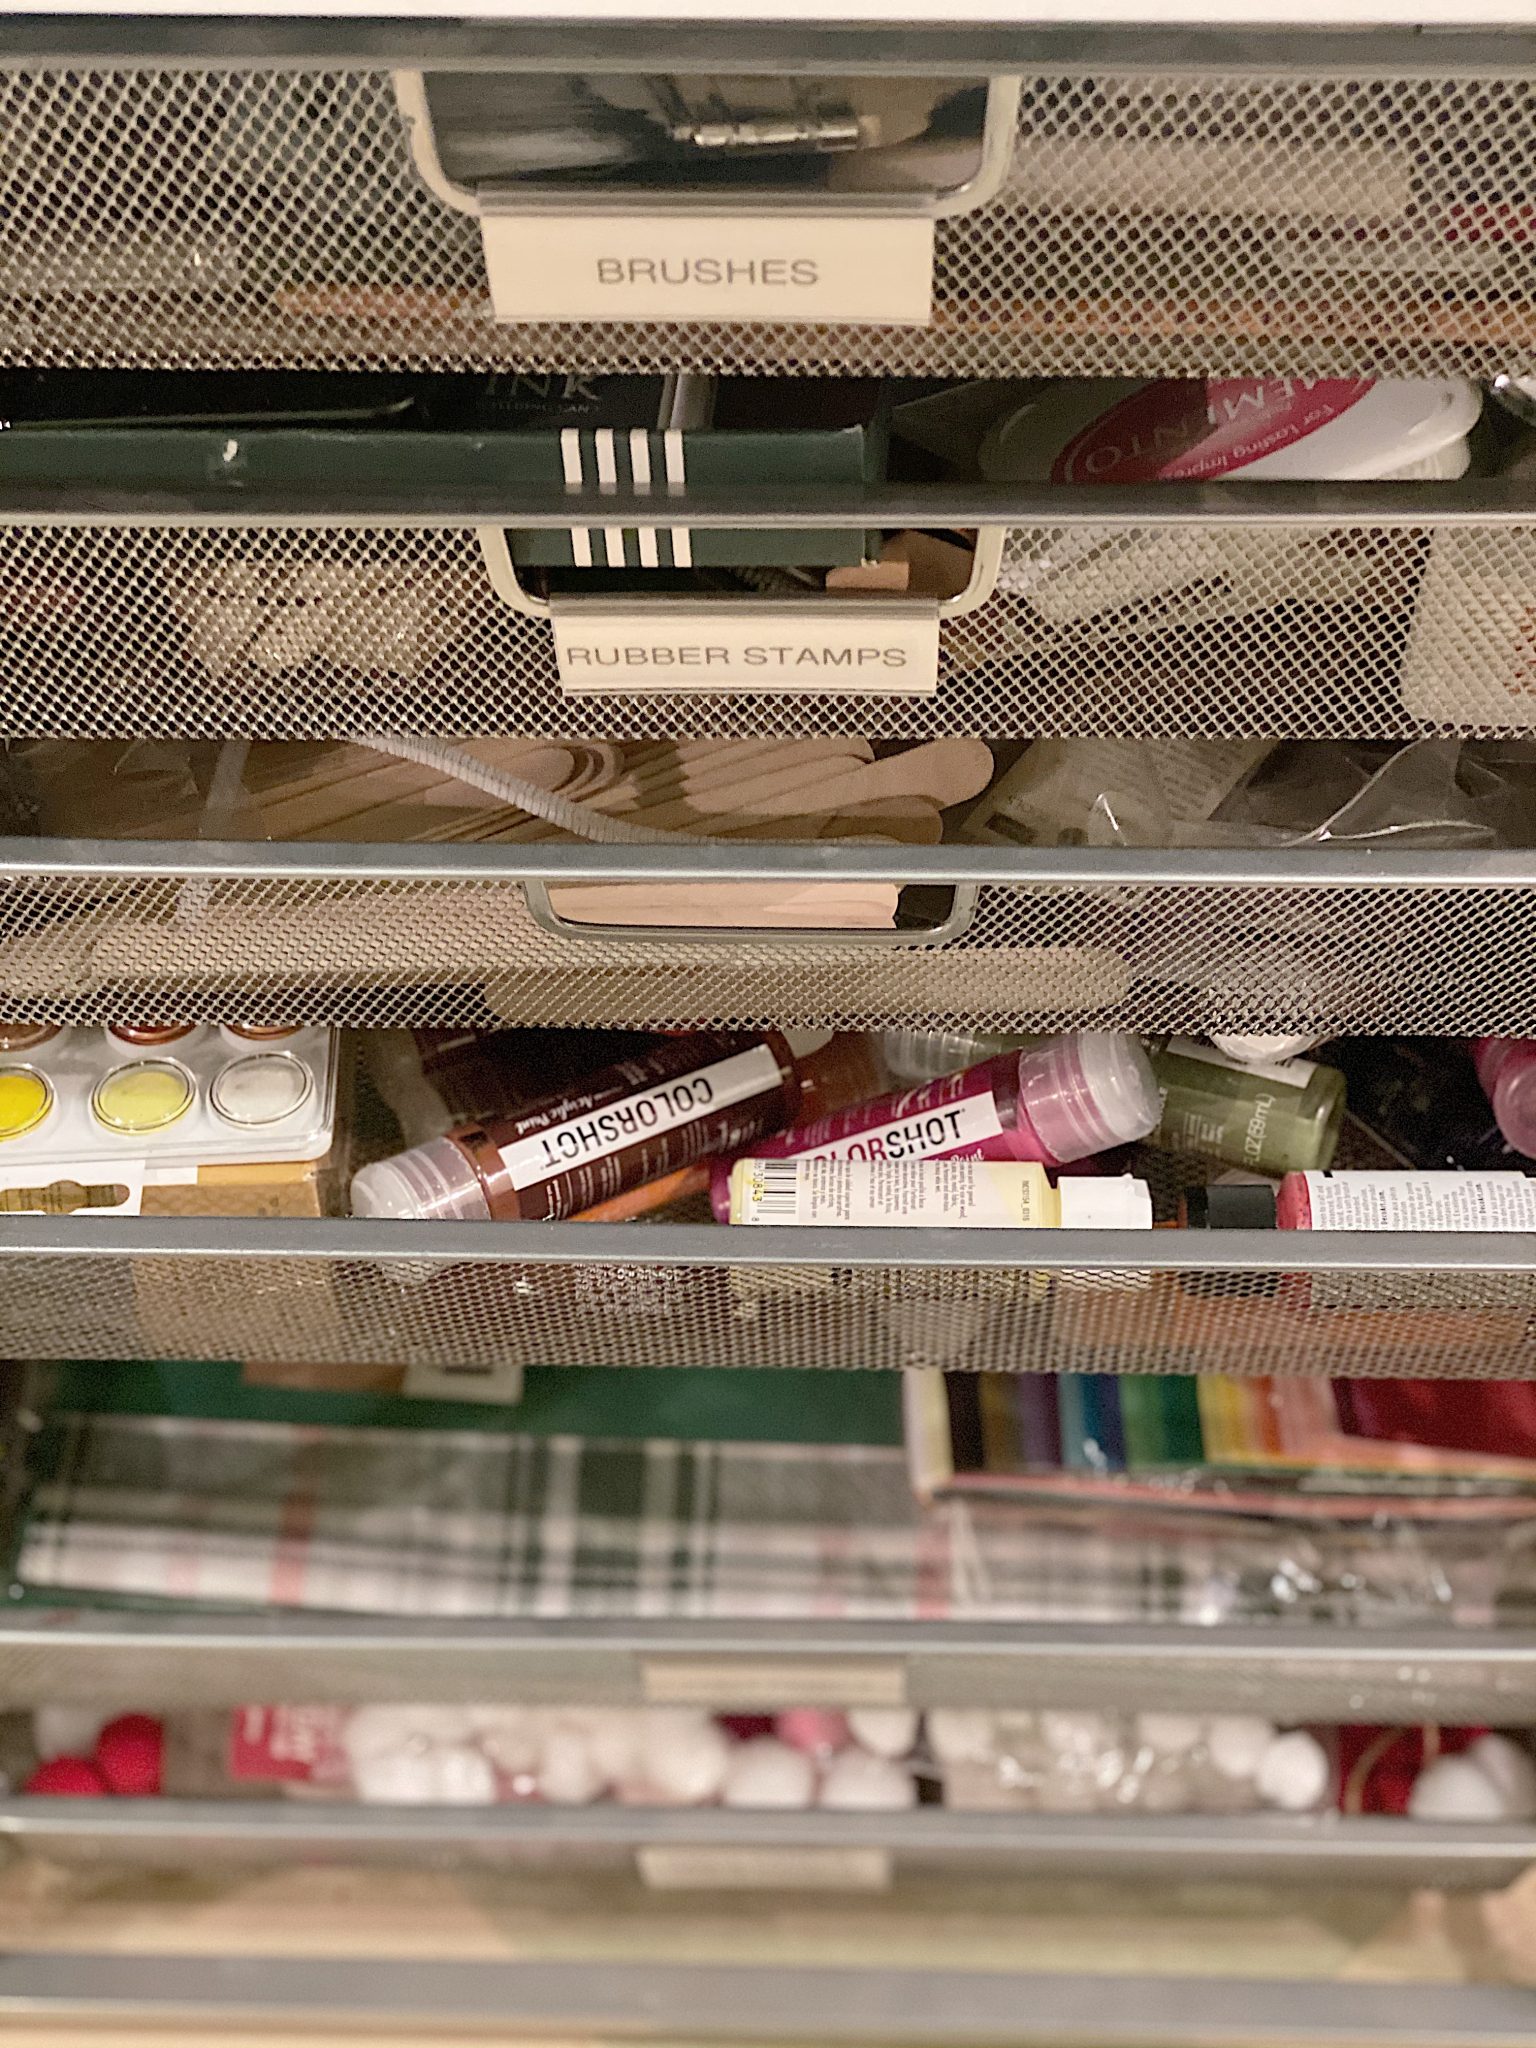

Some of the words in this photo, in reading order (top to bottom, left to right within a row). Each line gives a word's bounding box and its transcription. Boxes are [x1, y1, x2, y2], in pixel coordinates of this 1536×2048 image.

[597, 258, 819, 286] BRUSHES
[567, 646, 730, 667] RUBBER
[743, 646, 908, 668] STAMPS
[541, 1077, 714, 1169] COLORSHOT
